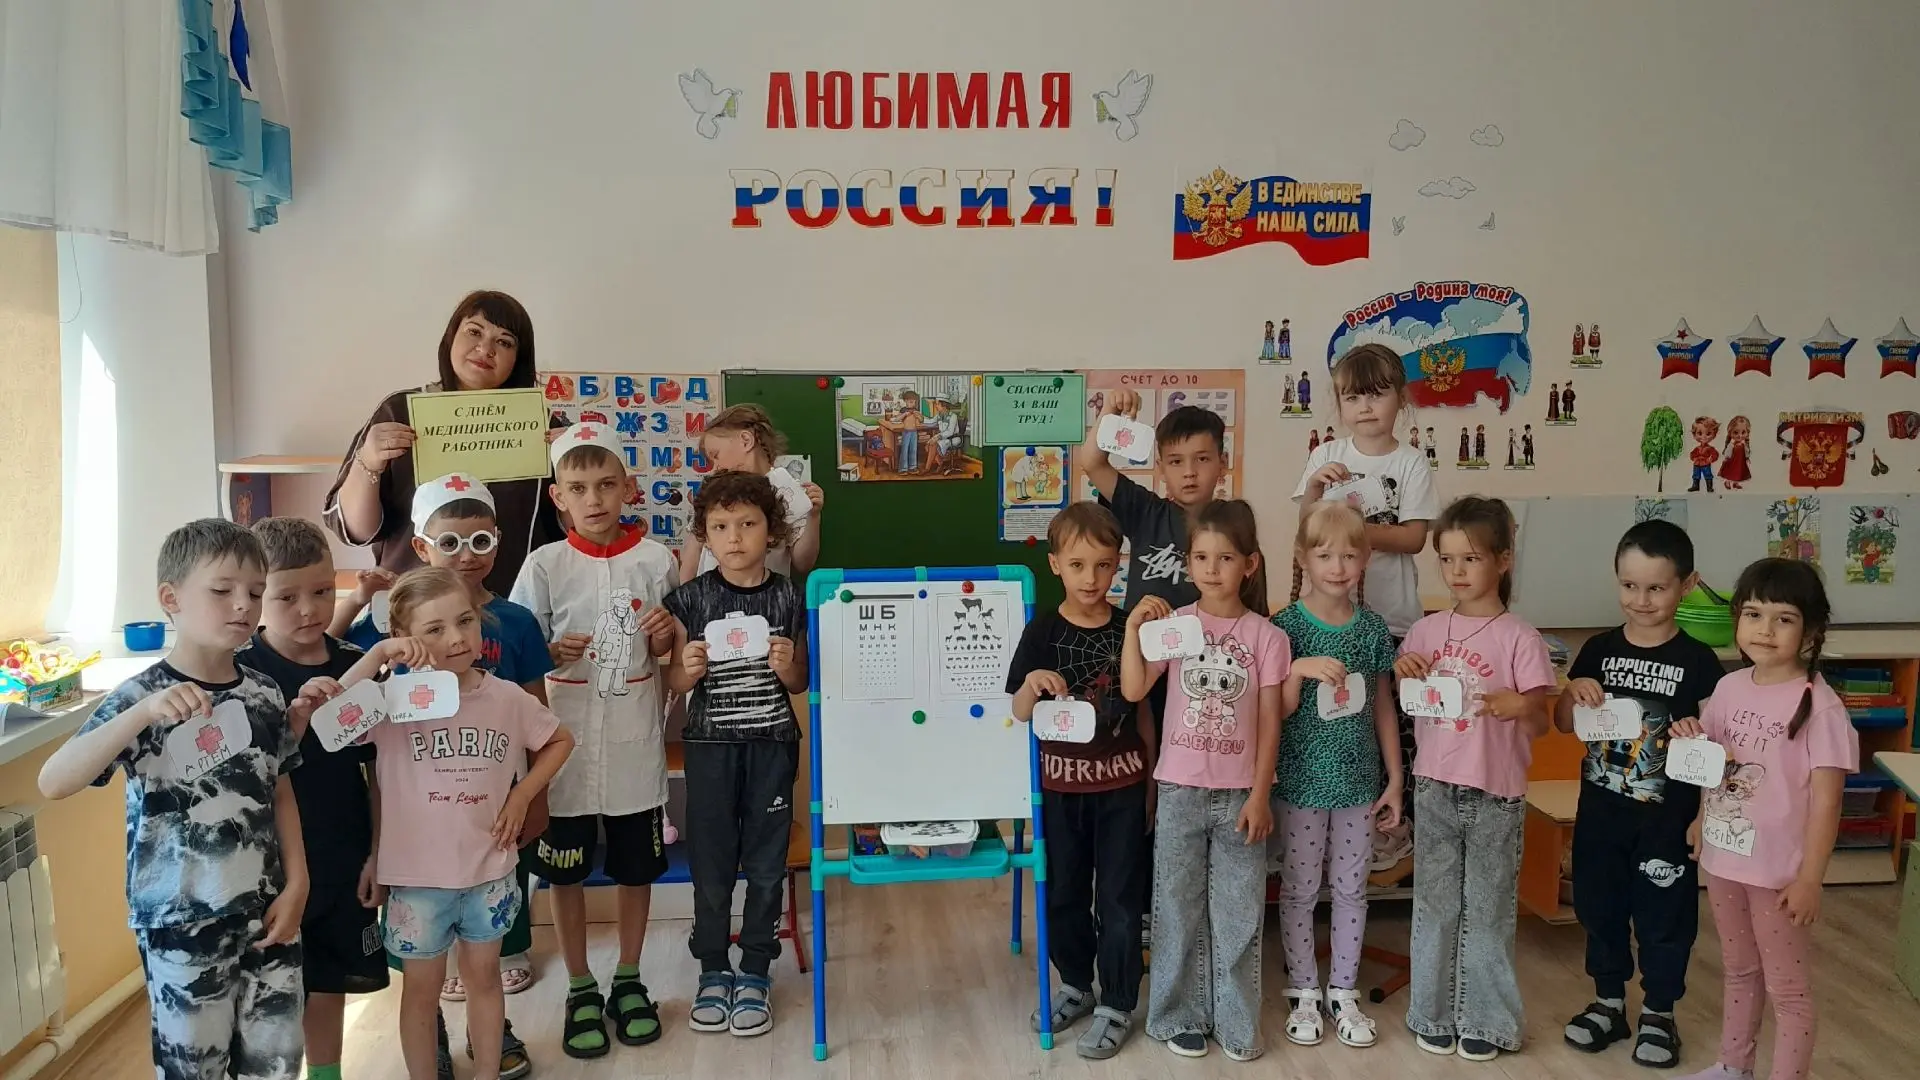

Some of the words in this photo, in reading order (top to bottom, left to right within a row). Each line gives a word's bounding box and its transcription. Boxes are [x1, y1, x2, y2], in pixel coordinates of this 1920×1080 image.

[766, 70, 1073, 130] ЛЮБИМАЯ
[1257, 181, 1269, 203] В
[1272, 181, 1363, 207] ЕДИНСТВЕ
[1256, 210, 1308, 233] НАША
[1313, 211, 1360, 233] СИЛА
[1345, 294, 1396, 328] Россия
[1415, 282, 1470, 302] Родина
[545, 375, 568, 400] А
[579, 375, 599, 396] Б
[615, 376, 634, 397] В
[650, 377, 667, 398] Г
[685, 377, 709, 401] Д
[1006, 384, 1062, 394] СПАСИБО
[1120, 374, 1153, 385] СЧЕТ
[1160, 374, 1179, 386] ДО
[1186, 374, 1198, 385] 10
[454, 406, 464, 418] С
[465, 403, 507, 418] ДНЁМ
[1012, 399, 1025, 409] ЗА
[1031, 399, 1059, 409] ВАШ
[422, 420, 539, 437] МЕДИЦИНСКОГО
[615, 411, 639, 432] Ж
[650, 412, 668, 433] З
[685, 412, 705, 433] И
[441, 439, 523, 453] РАБОТНИКА
[651, 446, 672, 468] М
[685, 446, 706, 468] Н
[651, 480, 671, 501] С
[652, 514, 675, 538] Ц
[1601, 656, 1685, 683] CAPPUCCINO
[1602, 671, 1677, 697] ASSASSINO
[1732, 708, 1766, 730] LET'S
[409, 726, 510, 763] PARIS
[1169, 731, 1246, 755] LABUBU
[1753, 736, 1769, 753] IT
[1040, 750, 1143, 783] IDER-MAN
[428, 791, 451, 803] Team
[455, 791, 489, 804] League
[537, 838, 584, 869] DENIM
